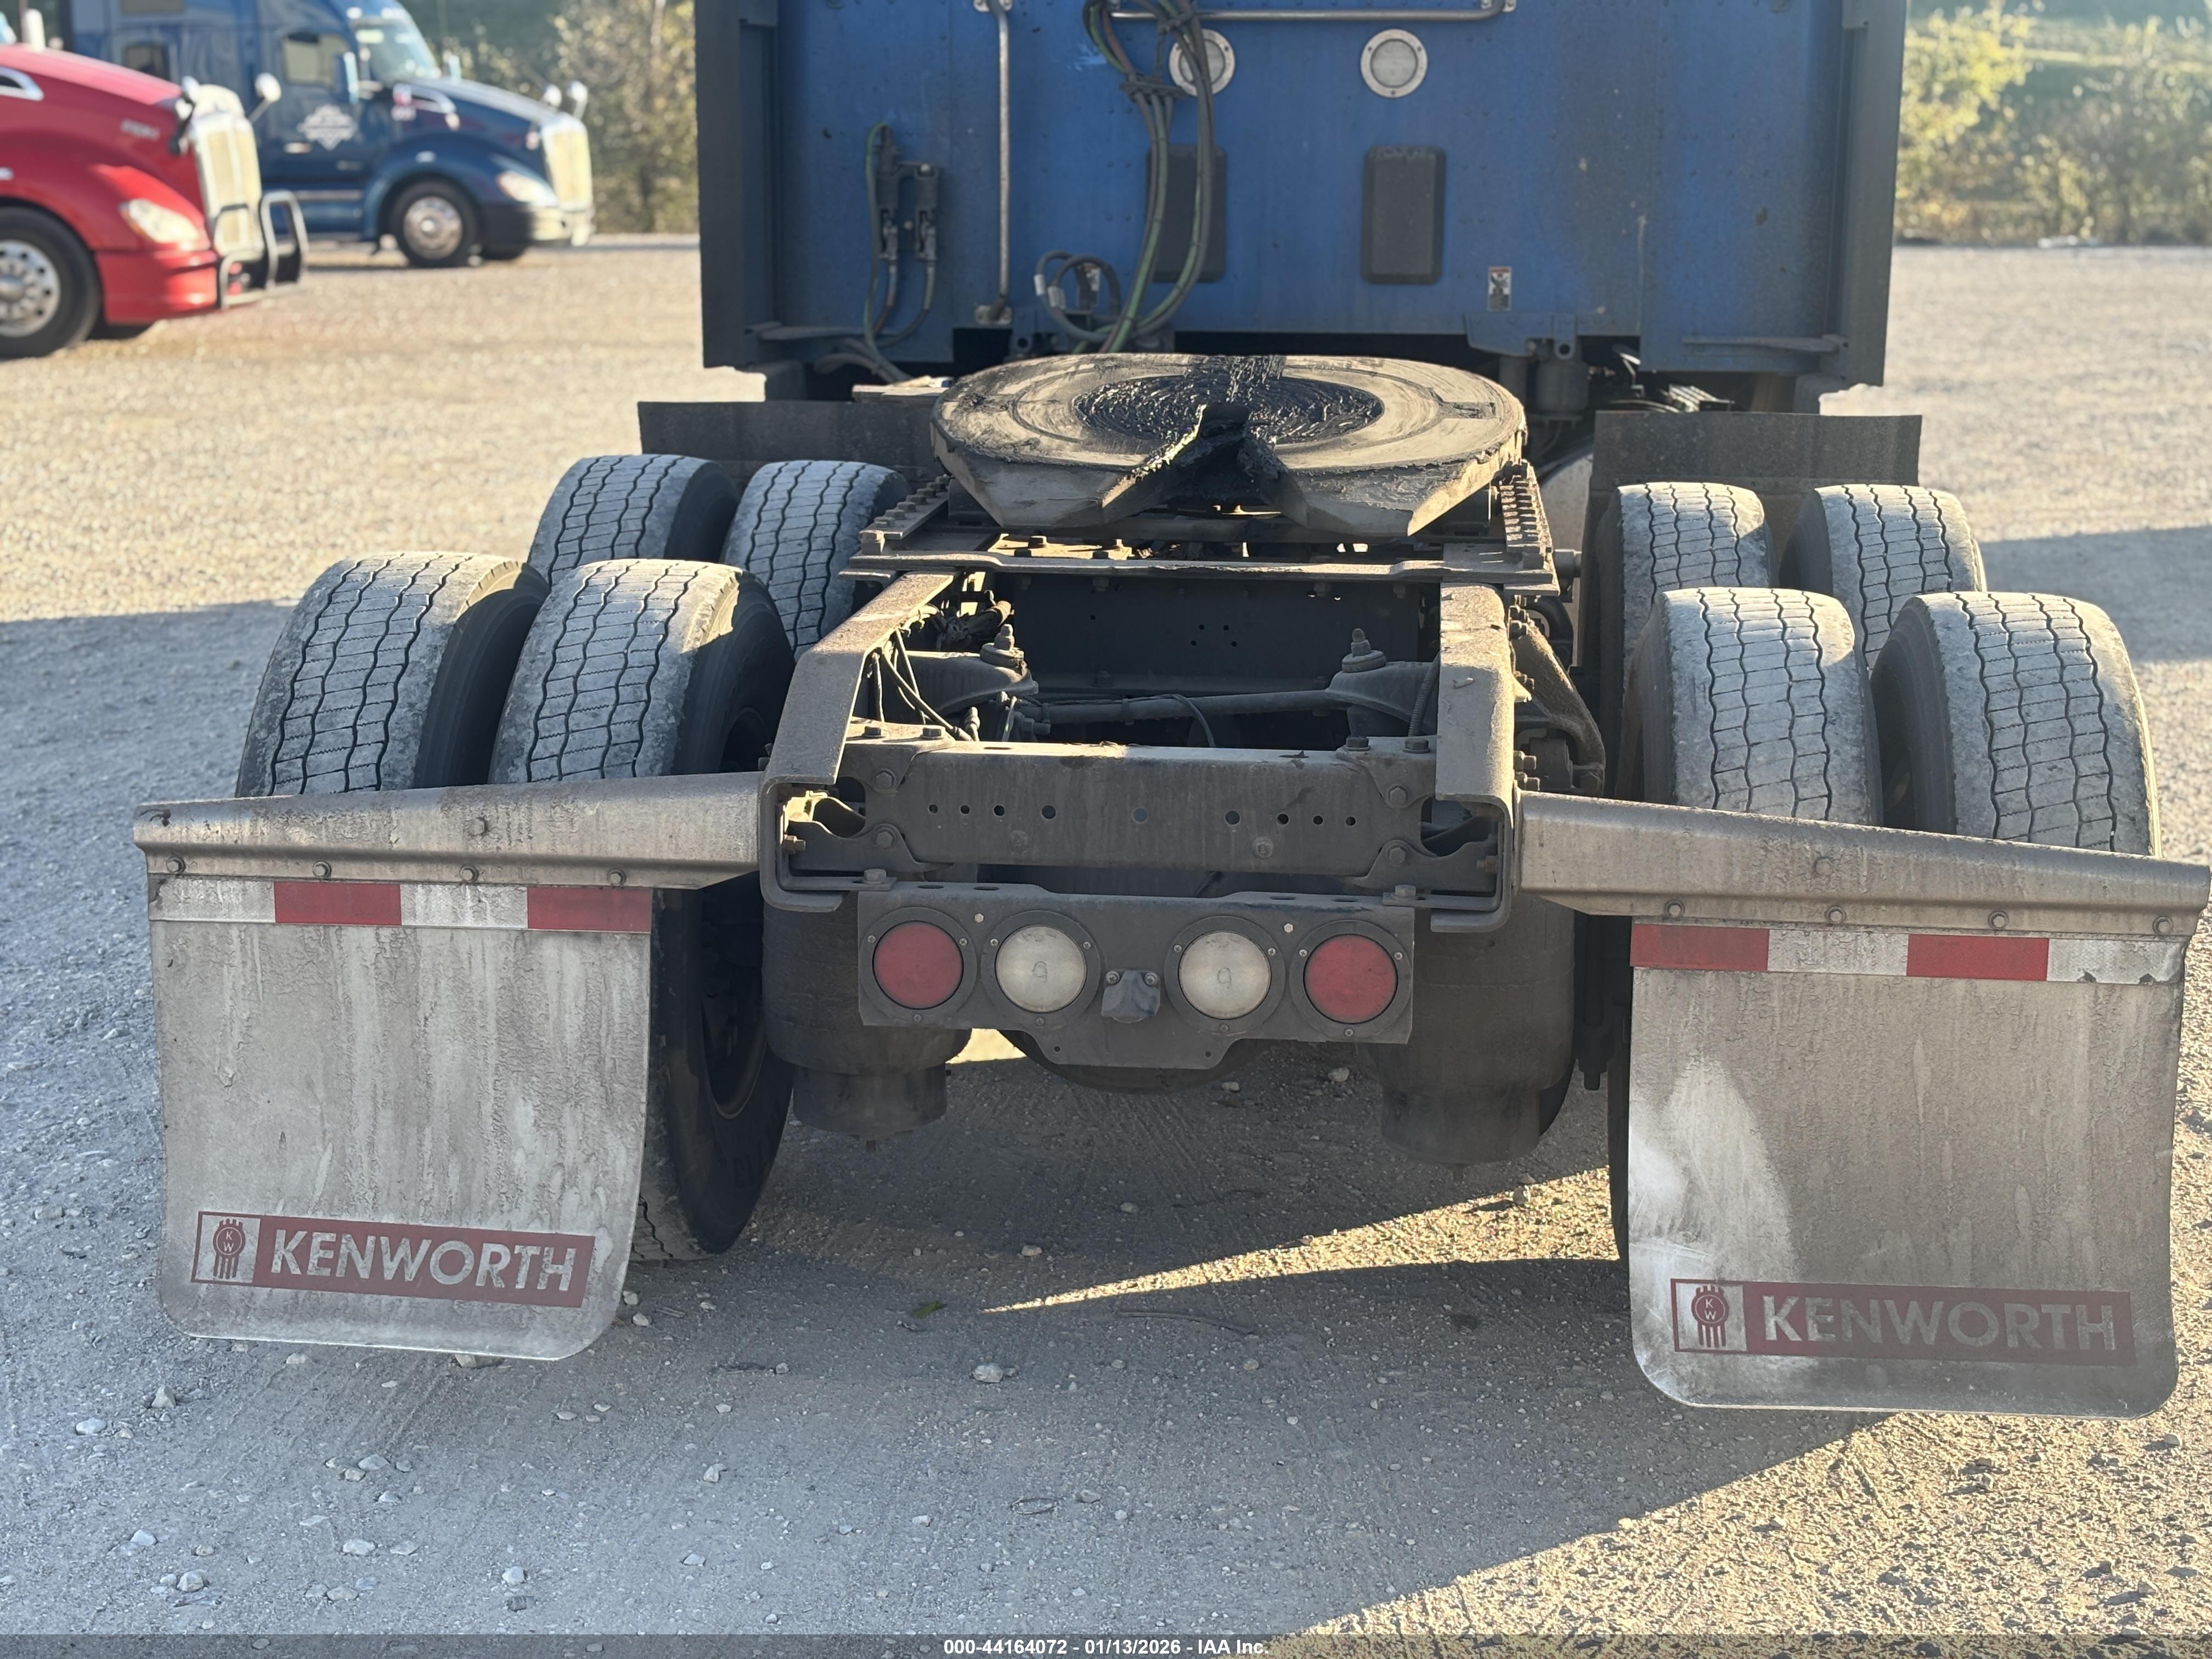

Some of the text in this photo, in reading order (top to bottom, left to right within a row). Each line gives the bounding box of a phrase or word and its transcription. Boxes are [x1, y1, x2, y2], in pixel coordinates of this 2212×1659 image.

[225, 1231, 233, 1240] K
[223, 1242, 234, 1252] W
[270, 1229, 577, 1292] KENWORTH
[1705, 1298, 1714, 1308] K
[1704, 1310, 1717, 1321] W
[1762, 1295, 2116, 1351] KENWORTH
